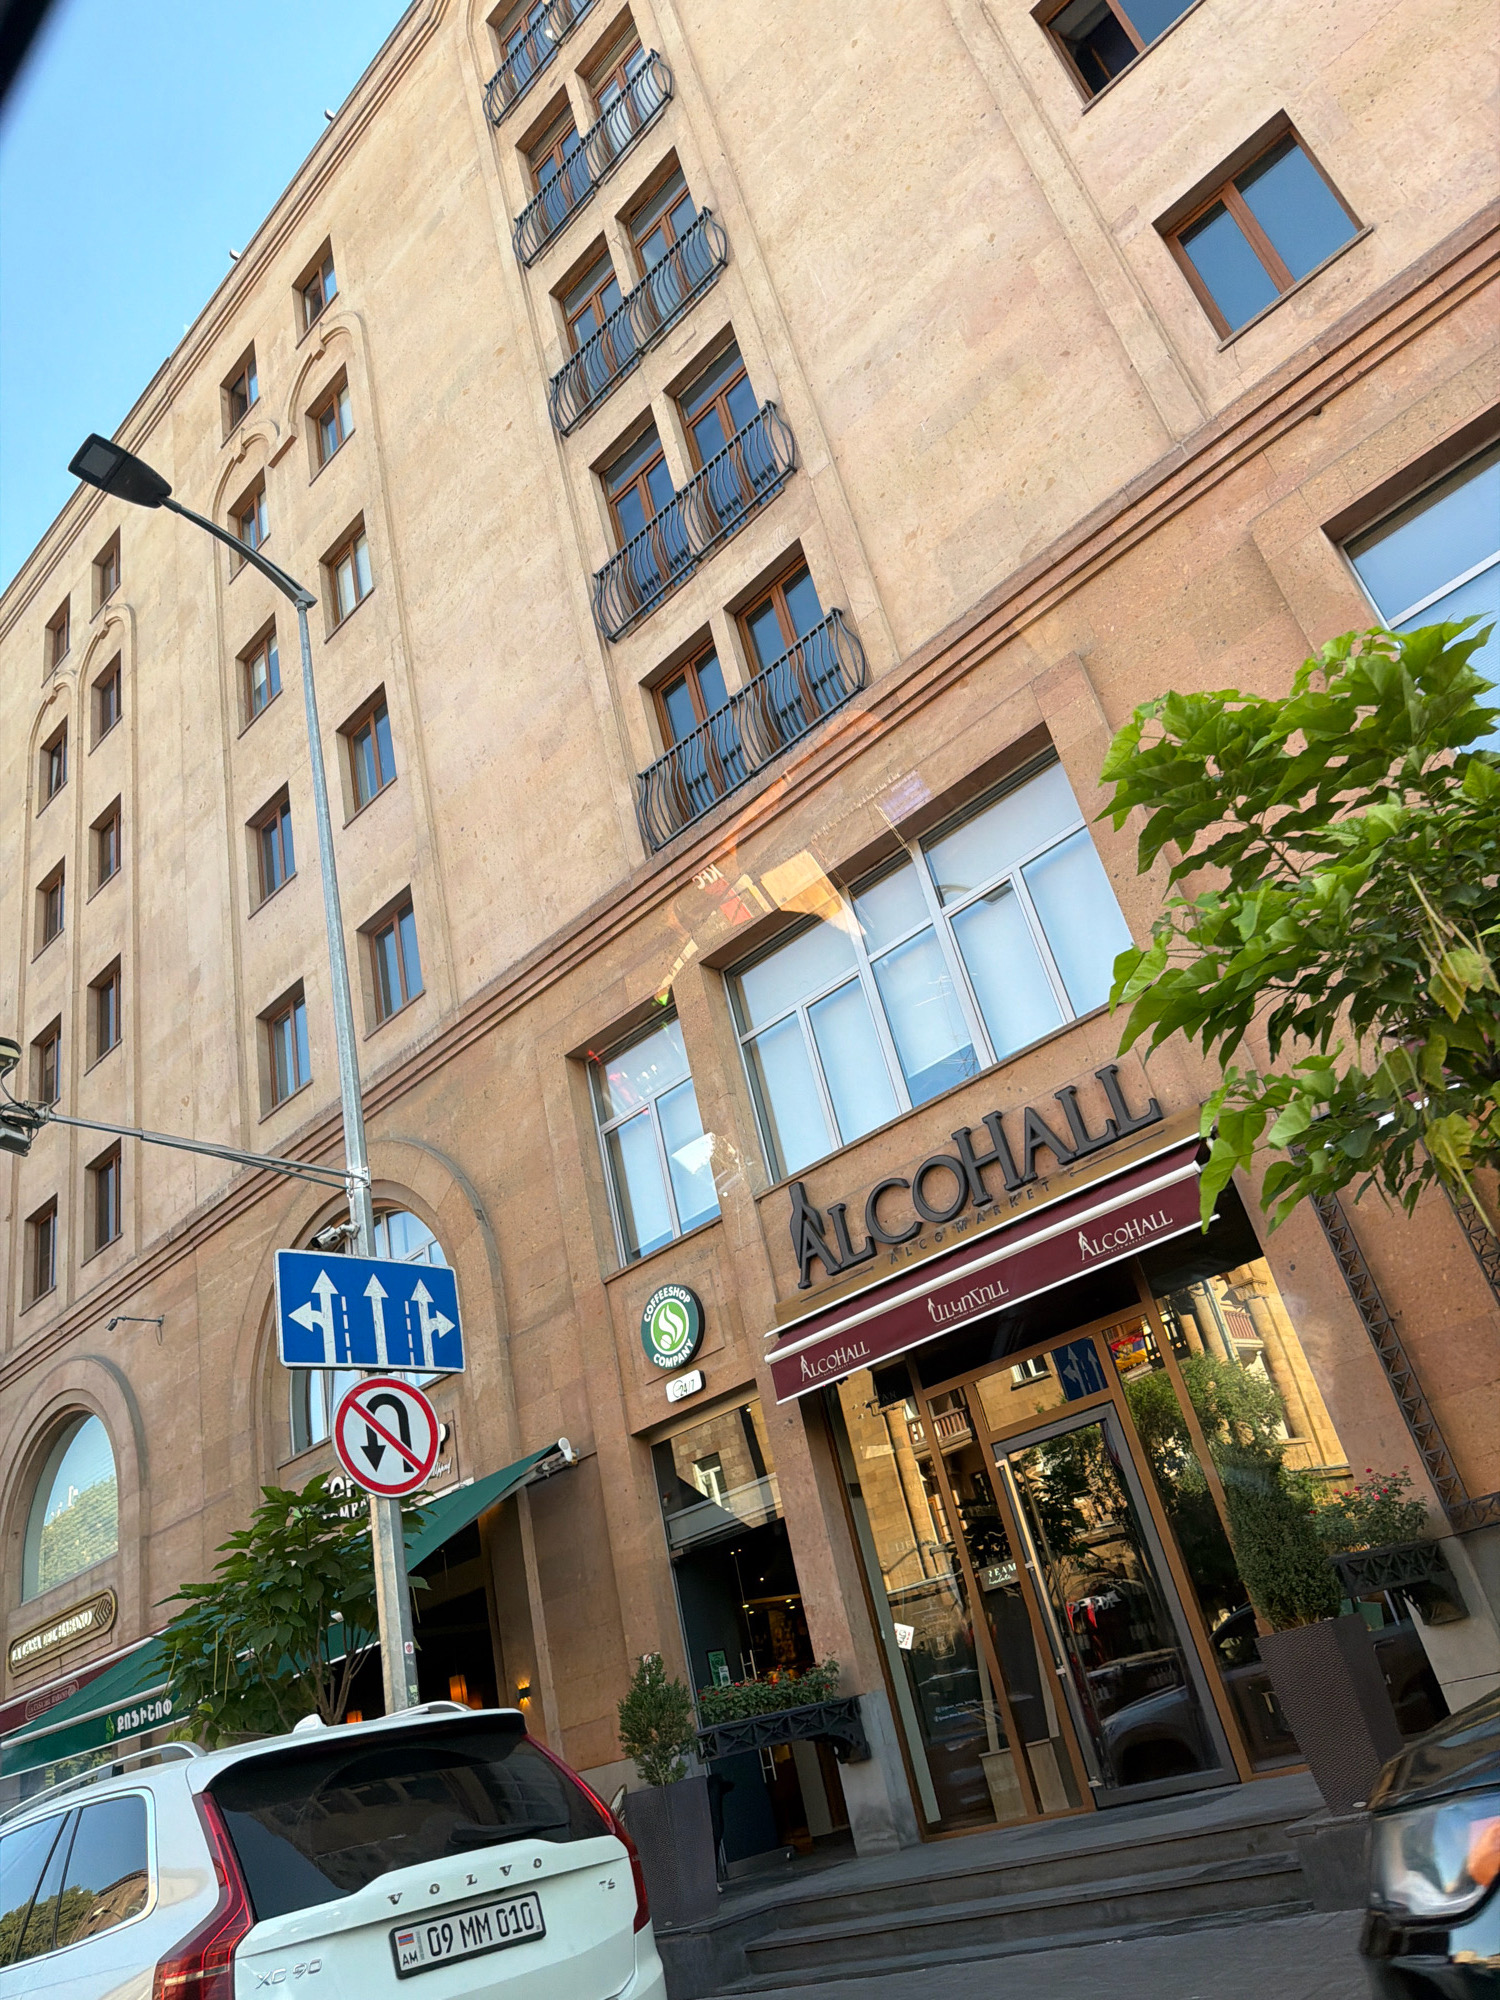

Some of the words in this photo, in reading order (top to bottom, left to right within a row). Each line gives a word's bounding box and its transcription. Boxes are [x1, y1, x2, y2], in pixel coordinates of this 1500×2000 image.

[789, 1064, 1164, 1289] ALCOHALL
[890, 1229, 944, 1265] ALCO
[956, 1180, 1051, 1234] MARKET
[1077, 1210, 1174, 1261] ALCOHALL
[643, 1286, 691, 1322] COFFEESHOP
[653, 1338, 694, 1368] COMPANY
[800, 1341, 870, 1382] ALCOHALL
[679, 1379, 695, 1397] 24/7
[387, 1858, 543, 1905] VOLVO
[427, 1923, 453, 1957] 09
[459, 1912, 493, 1948] MM
[496, 1902, 535, 1938] 010
[255, 1968, 286, 1989] XC
[293, 1959, 322, 1979] 90
[402, 1950, 418, 1966] AM
